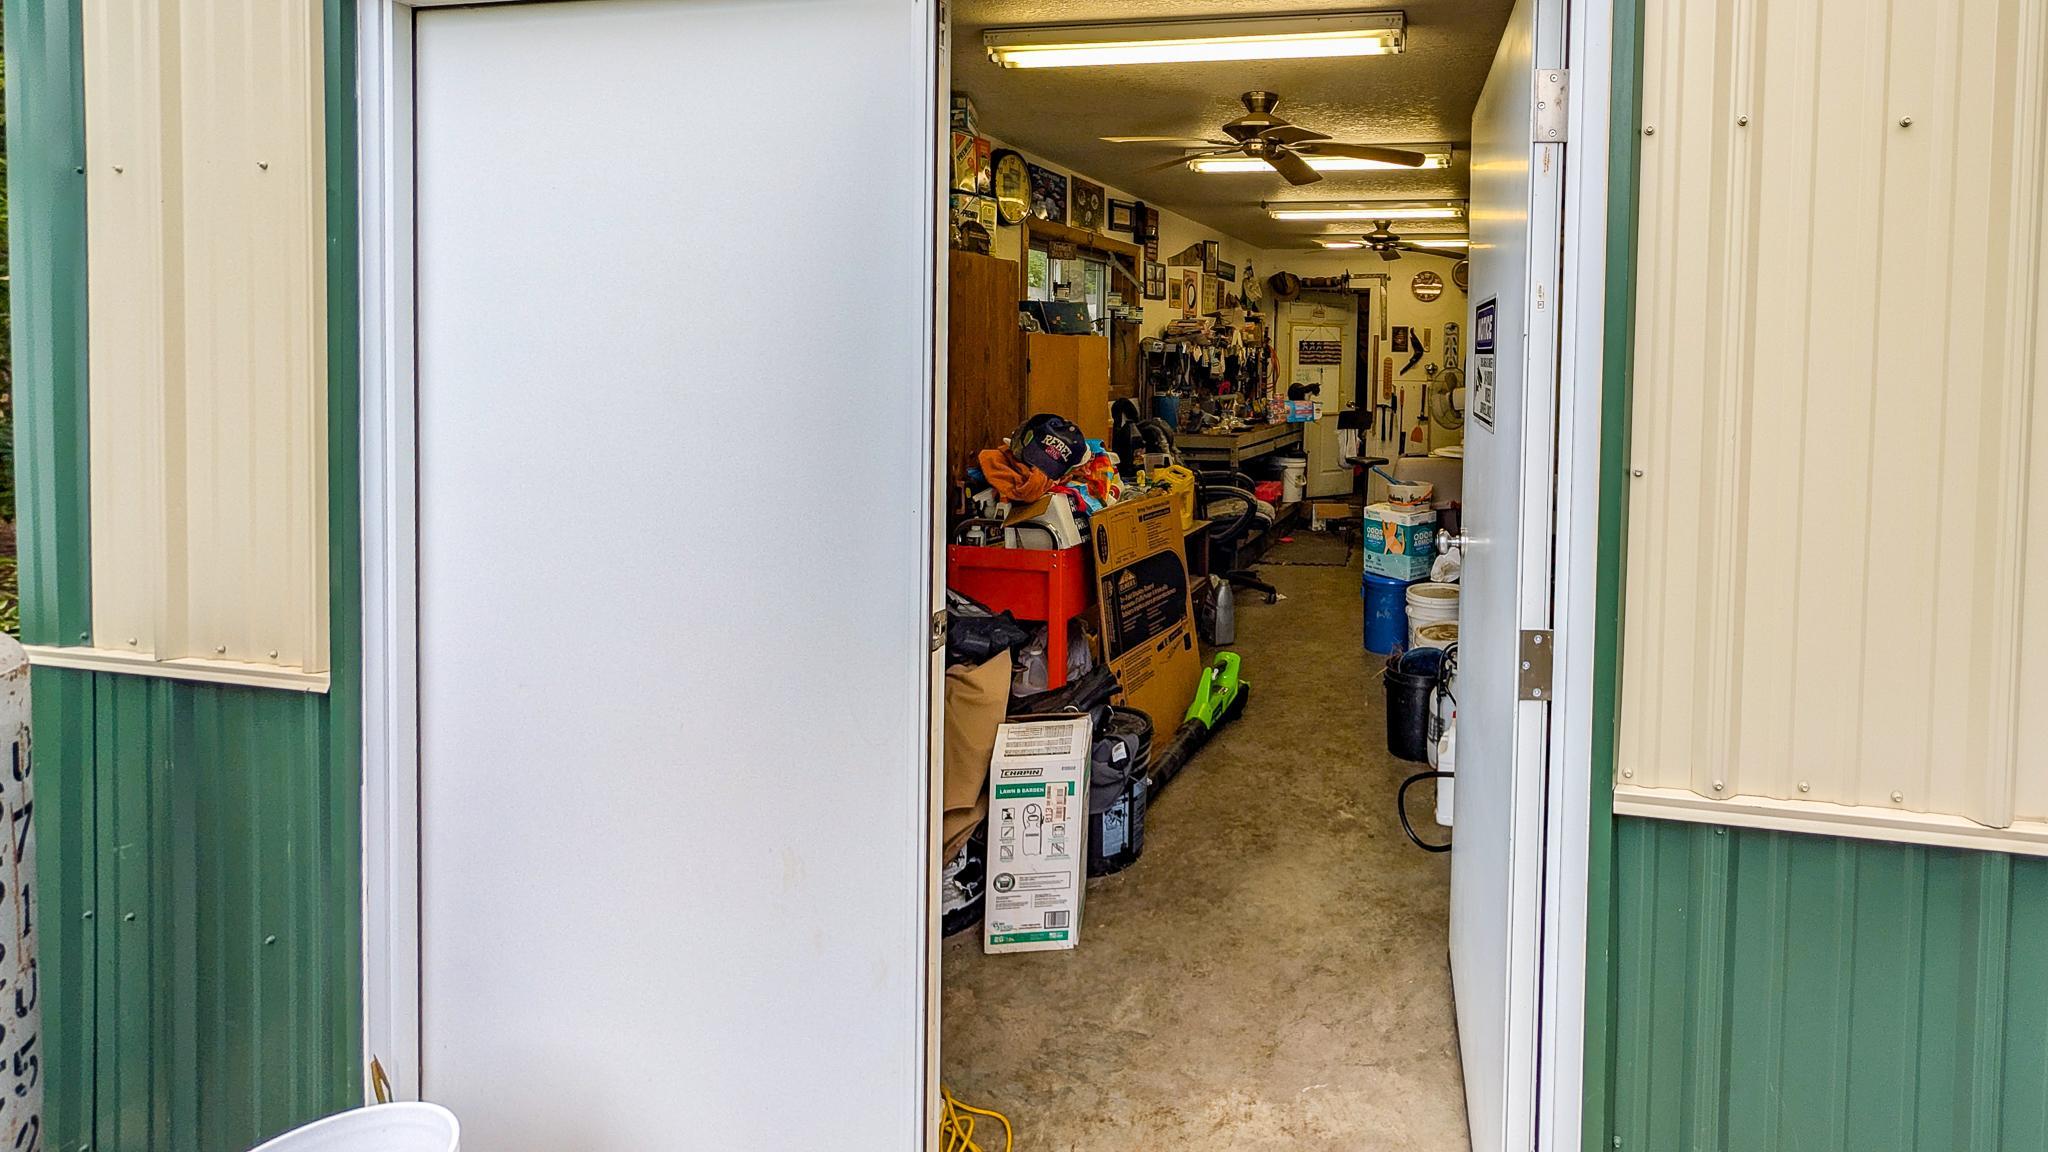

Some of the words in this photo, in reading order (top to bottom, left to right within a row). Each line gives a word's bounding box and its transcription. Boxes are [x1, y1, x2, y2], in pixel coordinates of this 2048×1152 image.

[1041, 434, 1073, 463] REBEL
[1413, 530, 1433, 541] ODOR
[1003, 769, 1041, 777] CHAPIN
[1021, 786, 1045, 794] GARDEN
